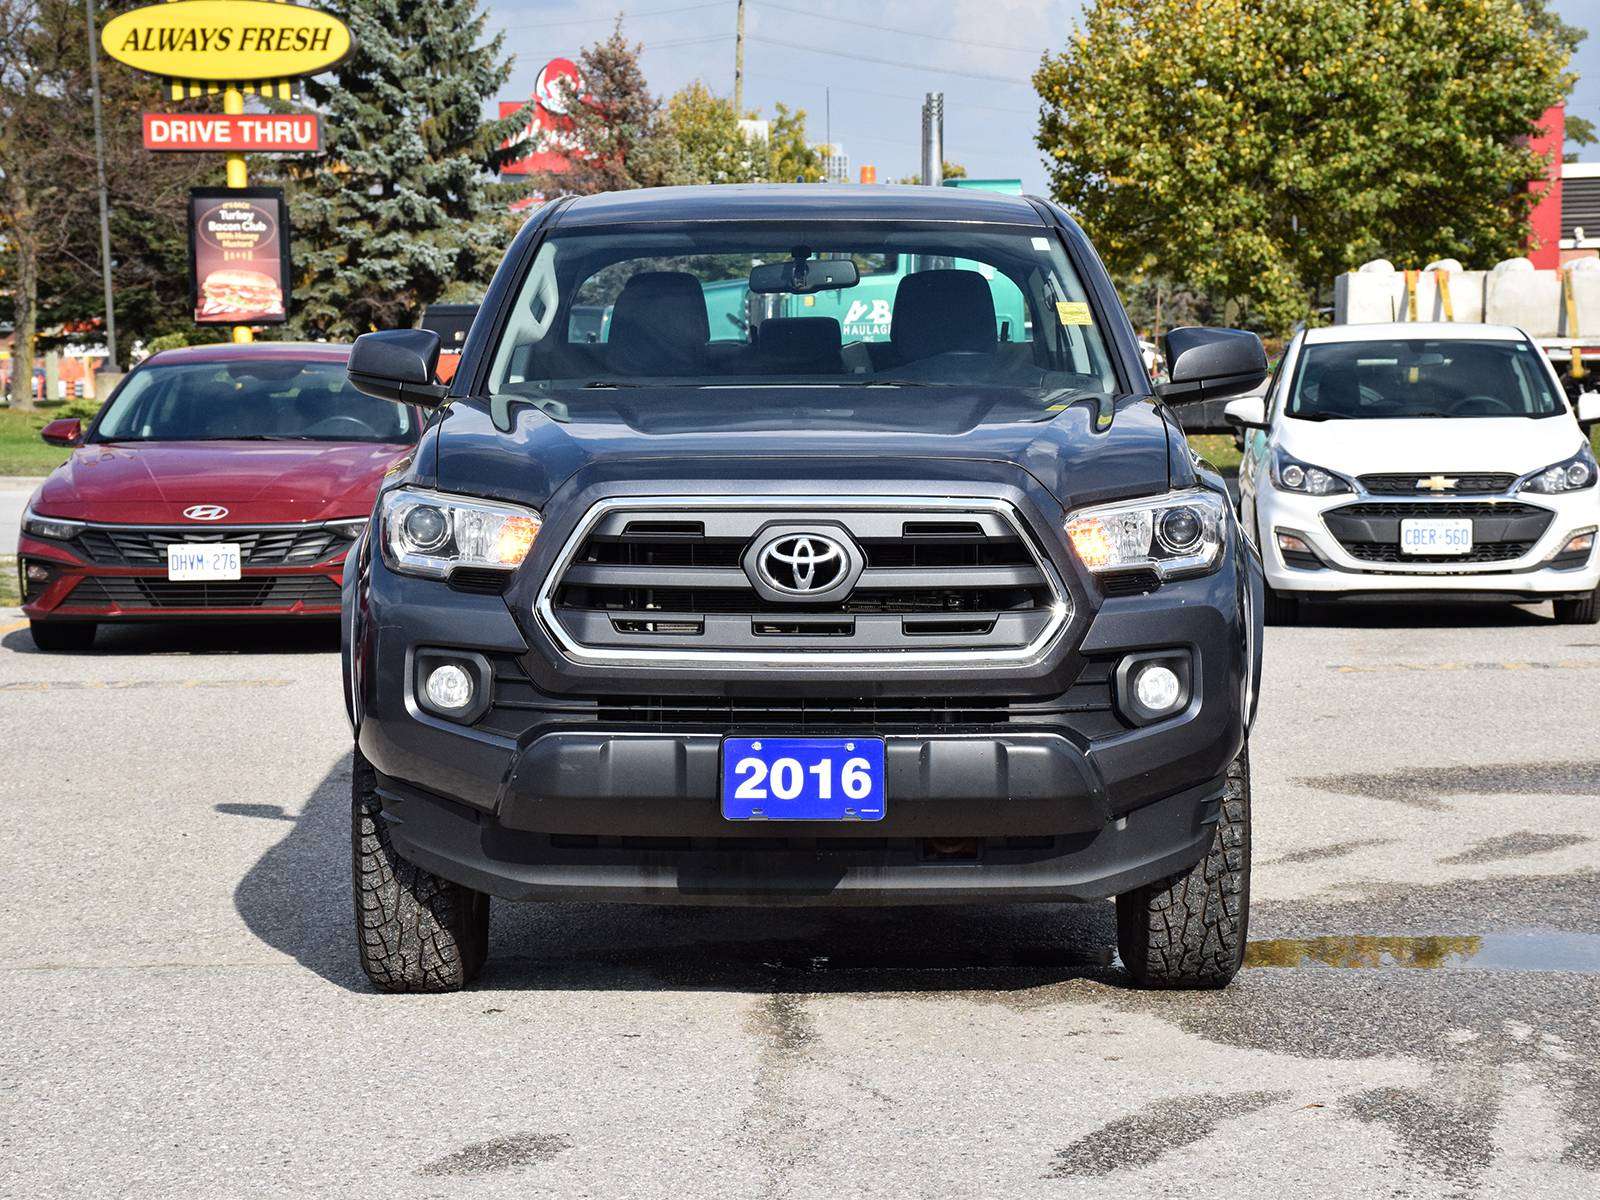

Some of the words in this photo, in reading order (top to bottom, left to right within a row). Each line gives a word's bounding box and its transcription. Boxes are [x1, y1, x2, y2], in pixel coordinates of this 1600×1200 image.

[121, 26, 233, 51] ALWAYS
[237, 26, 332, 51] FRESH
[150, 120, 232, 143] DRIVE
[237, 120, 312, 144] THRU
[219, 209, 255, 222] Turkey
[208, 221, 241, 231] Bacon
[241, 220, 267, 232] Club
[1404, 528, 1437, 545] CBER
[1445, 528, 1469, 545] 560
[171, 553, 204, 571] DHVM
[213, 553, 237, 571] 276
[734, 757, 872, 800] 2016
